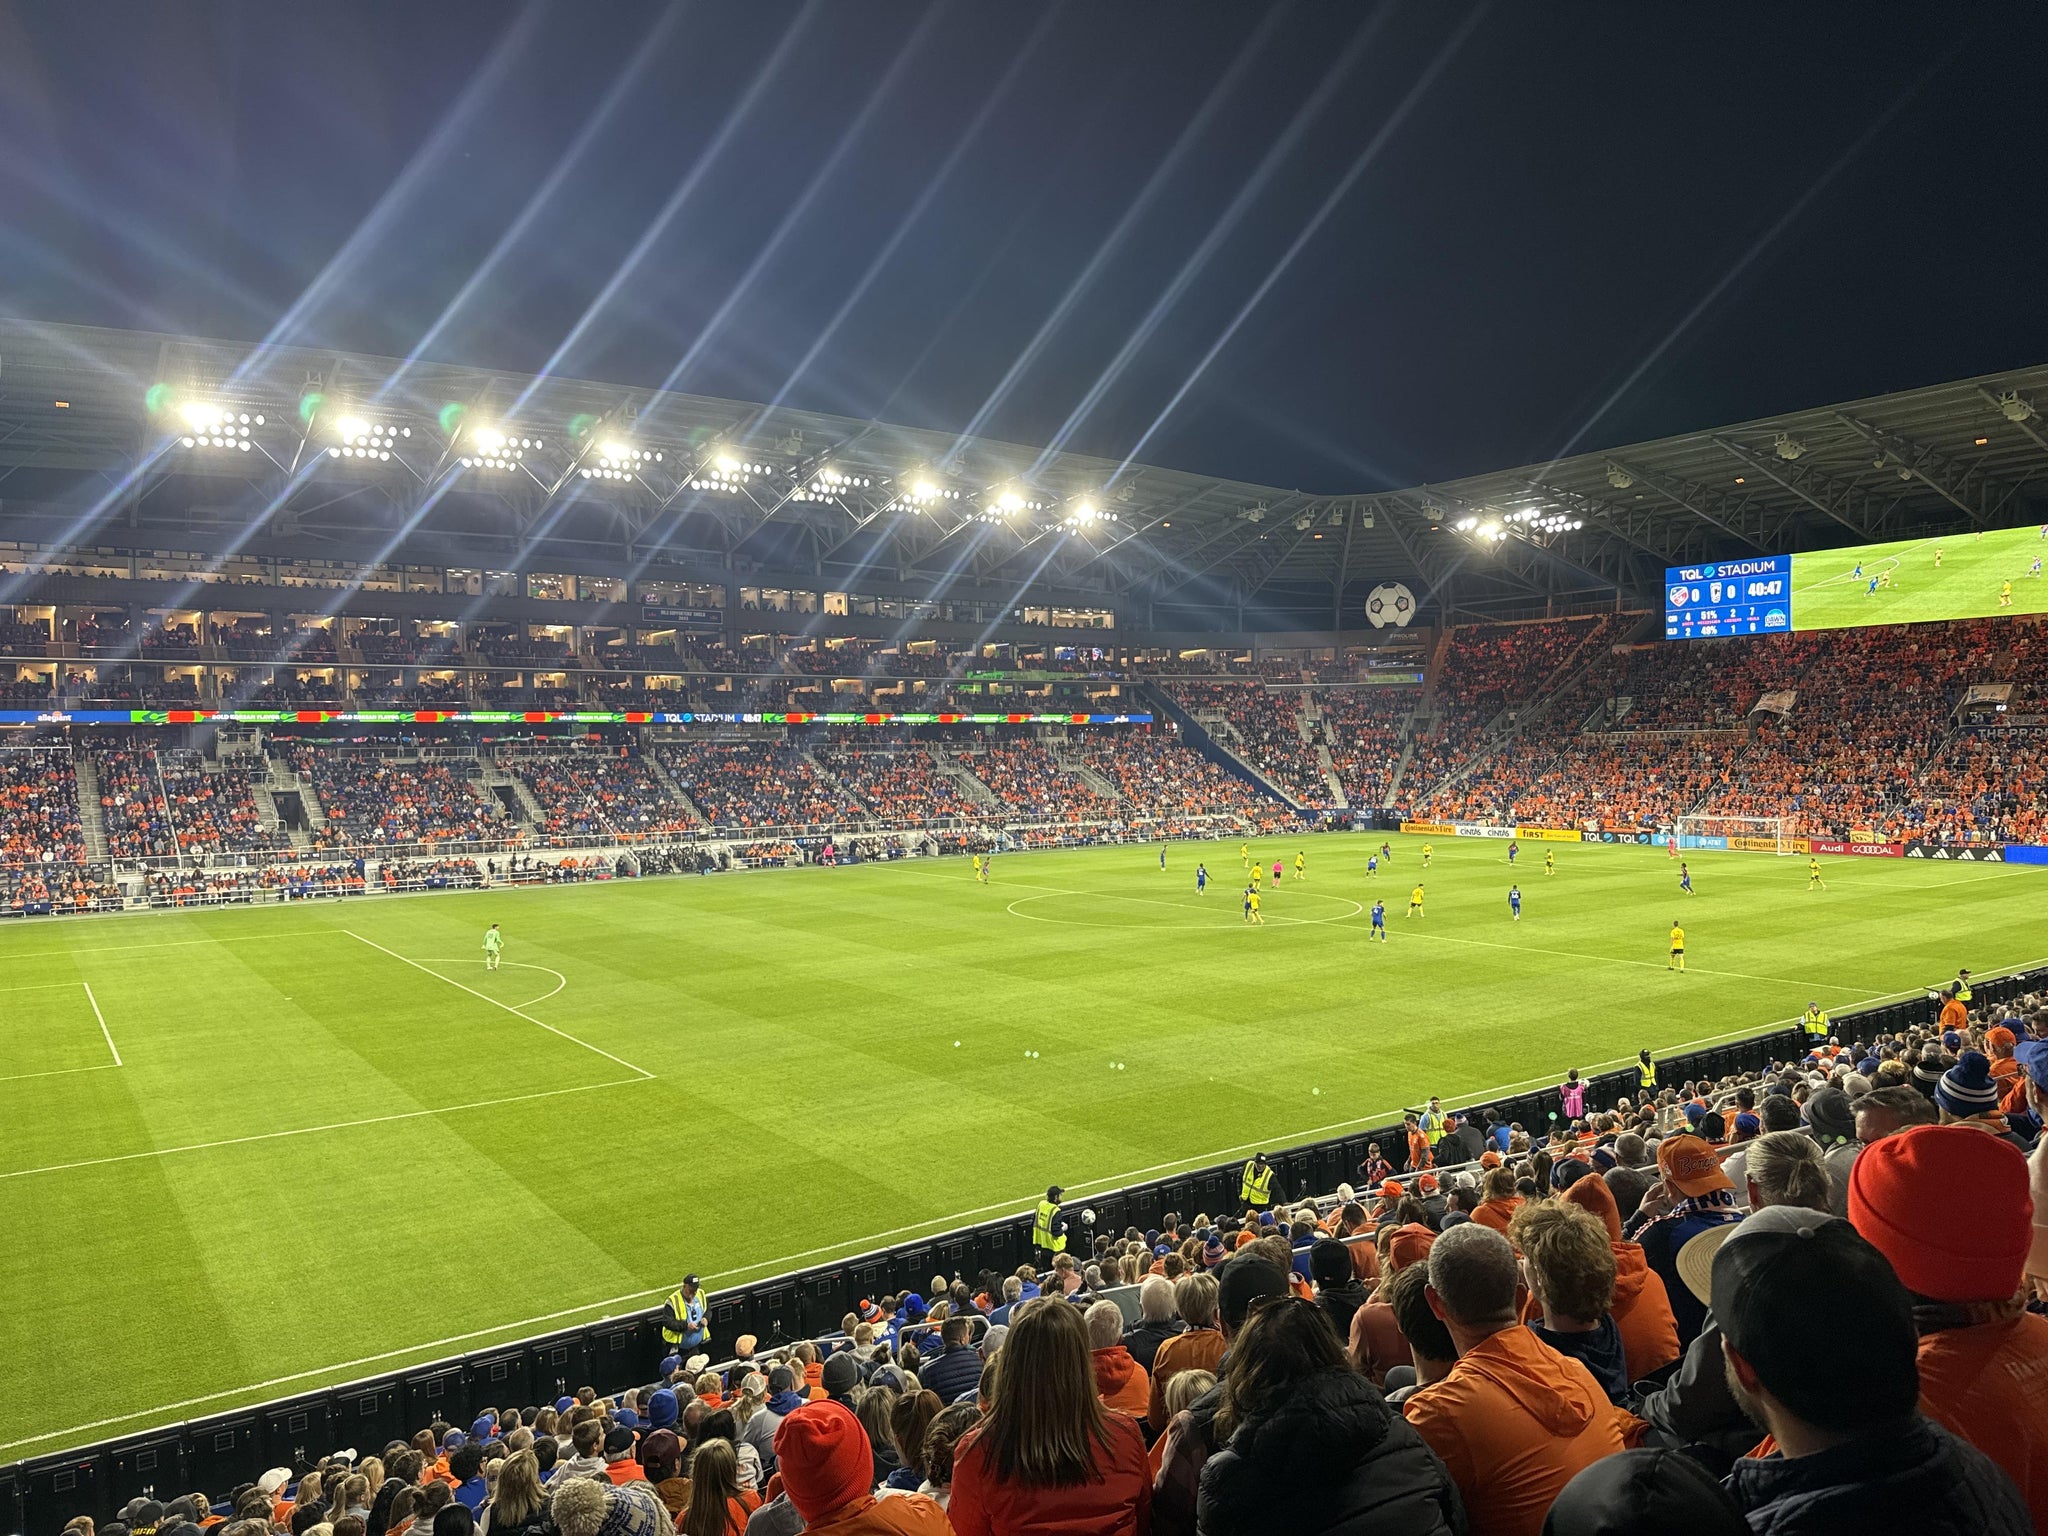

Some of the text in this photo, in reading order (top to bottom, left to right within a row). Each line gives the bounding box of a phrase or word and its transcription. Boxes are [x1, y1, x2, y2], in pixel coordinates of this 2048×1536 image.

[1680, 560, 1775, 580] TQL STADIUM
[1691, 584, 1736, 602] 0 0
[1748, 580, 1782, 597] 40:47
[1730, 608, 1736, 618] 2
[1750, 606, 1755, 616] 7
[1685, 627, 1691, 637] 2
[1731, 624, 1736, 634] 1
[37, 713, 72, 723] allegiant
[664, 713, 683, 723] TQL
[1978, 728, 2005, 738] THE
[1404, 824, 1452, 833] Continental Tire
[1583, 832, 1603, 842] TQL
[1617, 833, 1638, 844] TQL
[1734, 838, 1805, 849] Continental Tire
[1819, 844, 1844, 852] Audi
